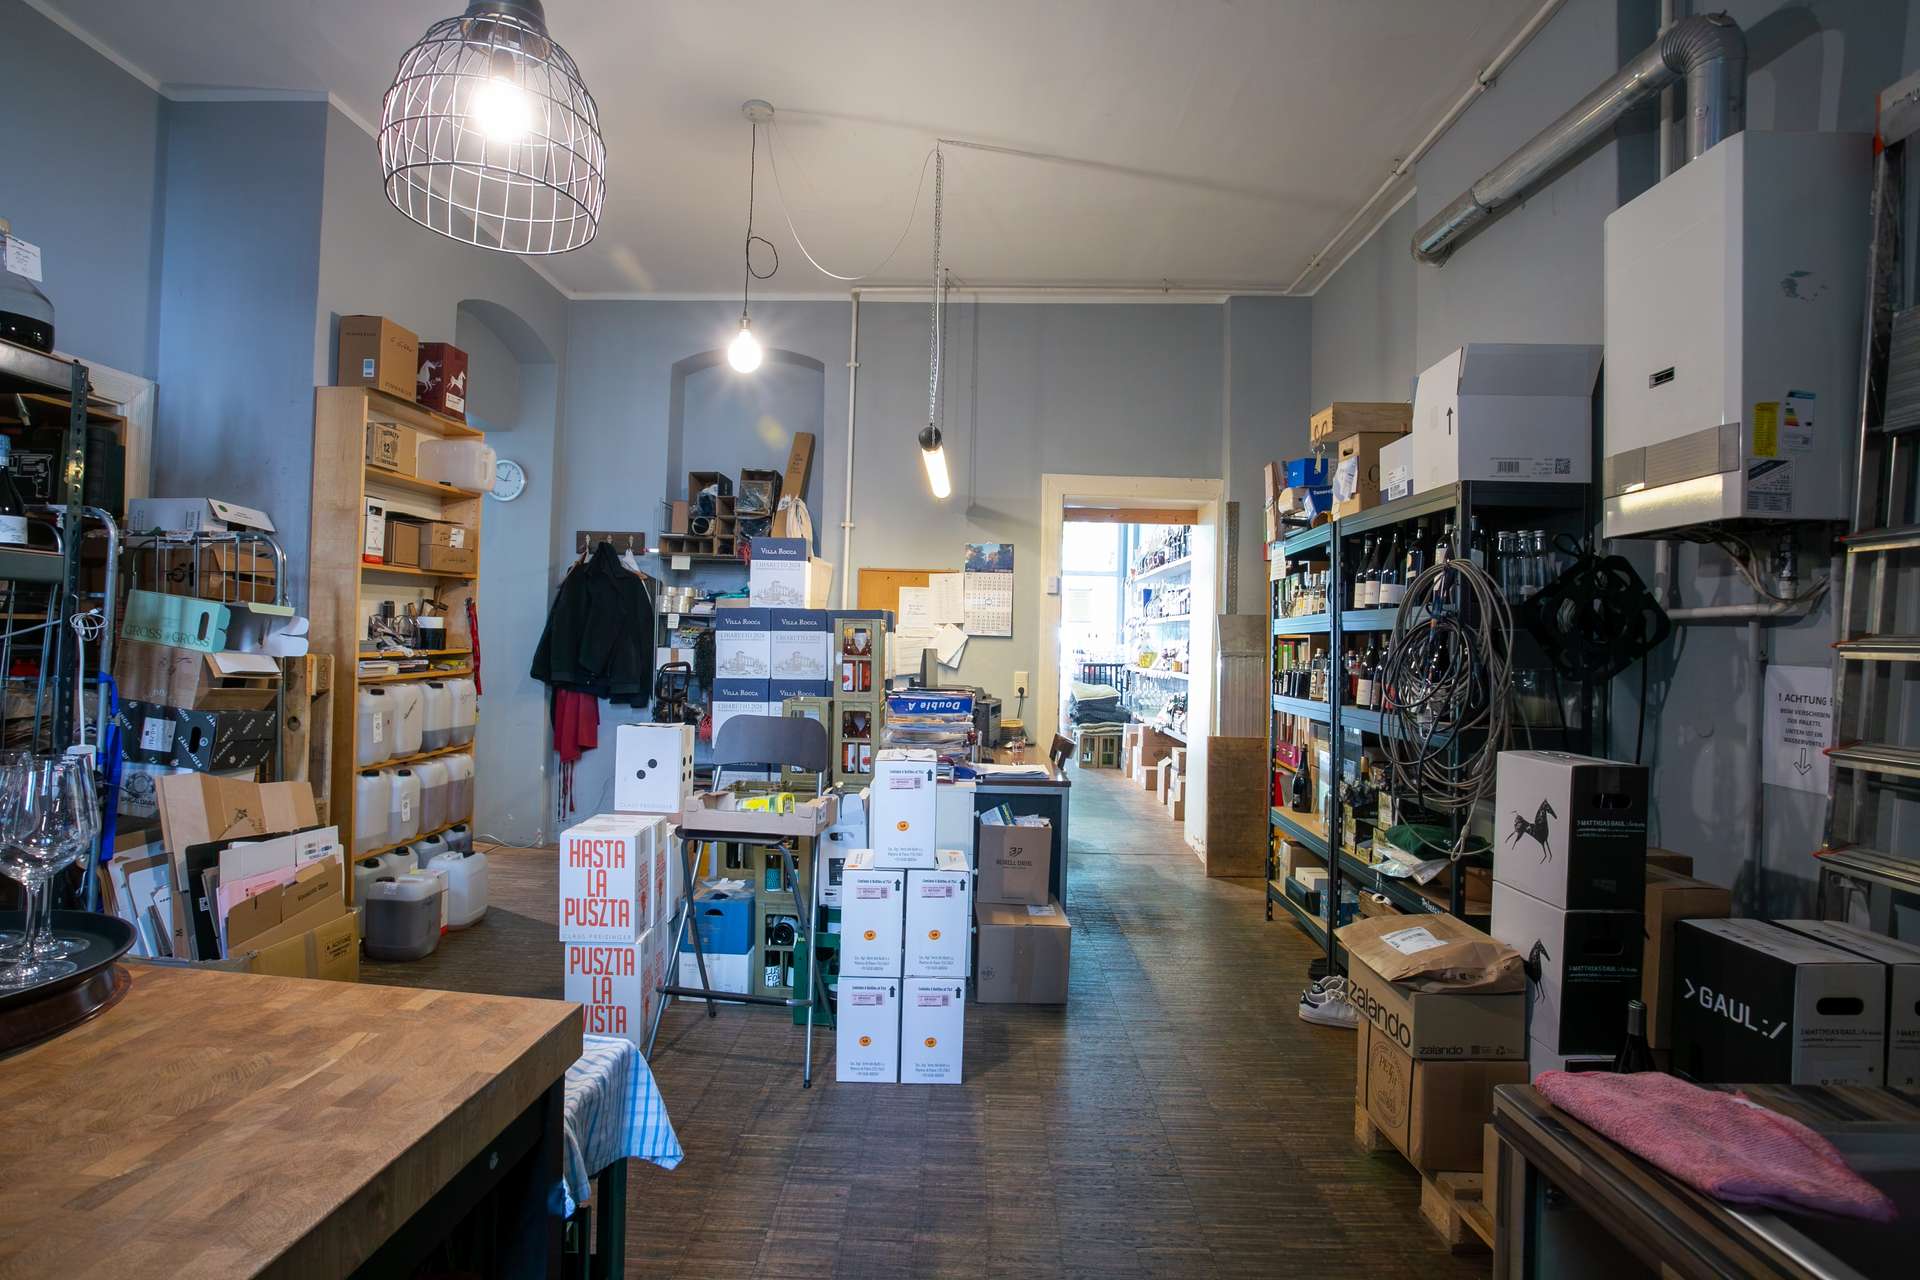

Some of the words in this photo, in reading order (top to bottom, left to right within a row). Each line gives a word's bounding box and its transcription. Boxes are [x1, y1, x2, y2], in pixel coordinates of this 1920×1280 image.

[920, 701, 961, 711] Double
[1784, 693, 1827, 706] ACHTUNG
[569, 839, 625, 869] HASTA
[587, 869, 607, 898] LA
[564, 897, 630, 928] PUSZTA
[570, 946, 635, 976] PUSZTA
[592, 976, 612, 1004] LA
[1349, 979, 1411, 1048] zalando
[1419, 1044, 1464, 1056] zalando
